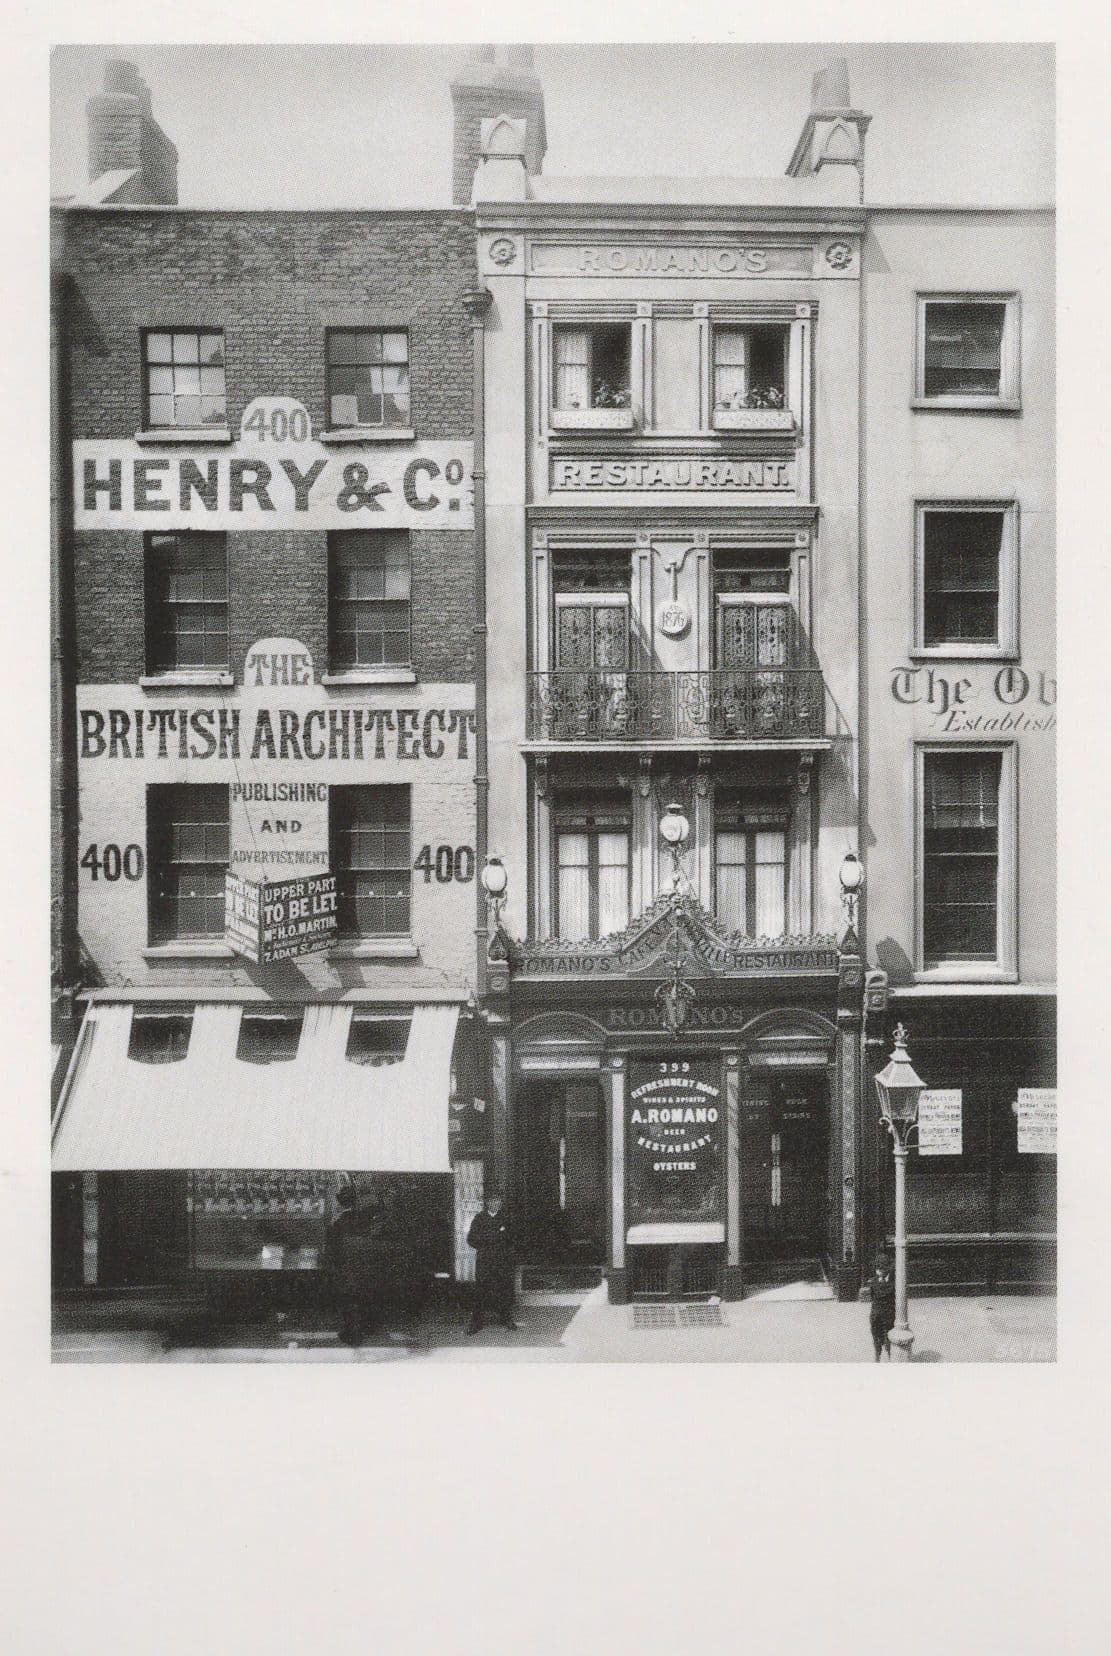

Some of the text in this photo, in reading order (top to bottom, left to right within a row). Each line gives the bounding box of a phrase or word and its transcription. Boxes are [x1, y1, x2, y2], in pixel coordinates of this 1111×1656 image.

[578, 248, 768, 274] ROMANO'S
[243, 407, 309, 443] 400
[82, 458, 327, 512] HENRY
[336, 461, 392, 512] &
[247, 653, 313, 687] THE
[889, 666, 972, 716] The
[79, 708, 476, 761] BRITISH ARCHITECT
[231, 783, 328, 803] PUBLISHING
[260, 819, 303, 834] AND
[80, 843, 145, 882] 400
[231, 850, 328, 866] ADVERTISEMENT
[413, 844, 476, 884] 400
[265, 883, 304, 903] UPPER
[308, 877, 337, 894] PART
[264, 902, 285, 925] TO
[288, 897, 309, 919] BE
[660, 1062, 691, 1073] 399
[631, 1078, 695, 1099] REFRESHMENT
[631, 1107, 719, 1124] A.ROMANO
[637, 1135, 712, 1153] RESTAURANT
[653, 1161, 697, 1171] OYSTERS
